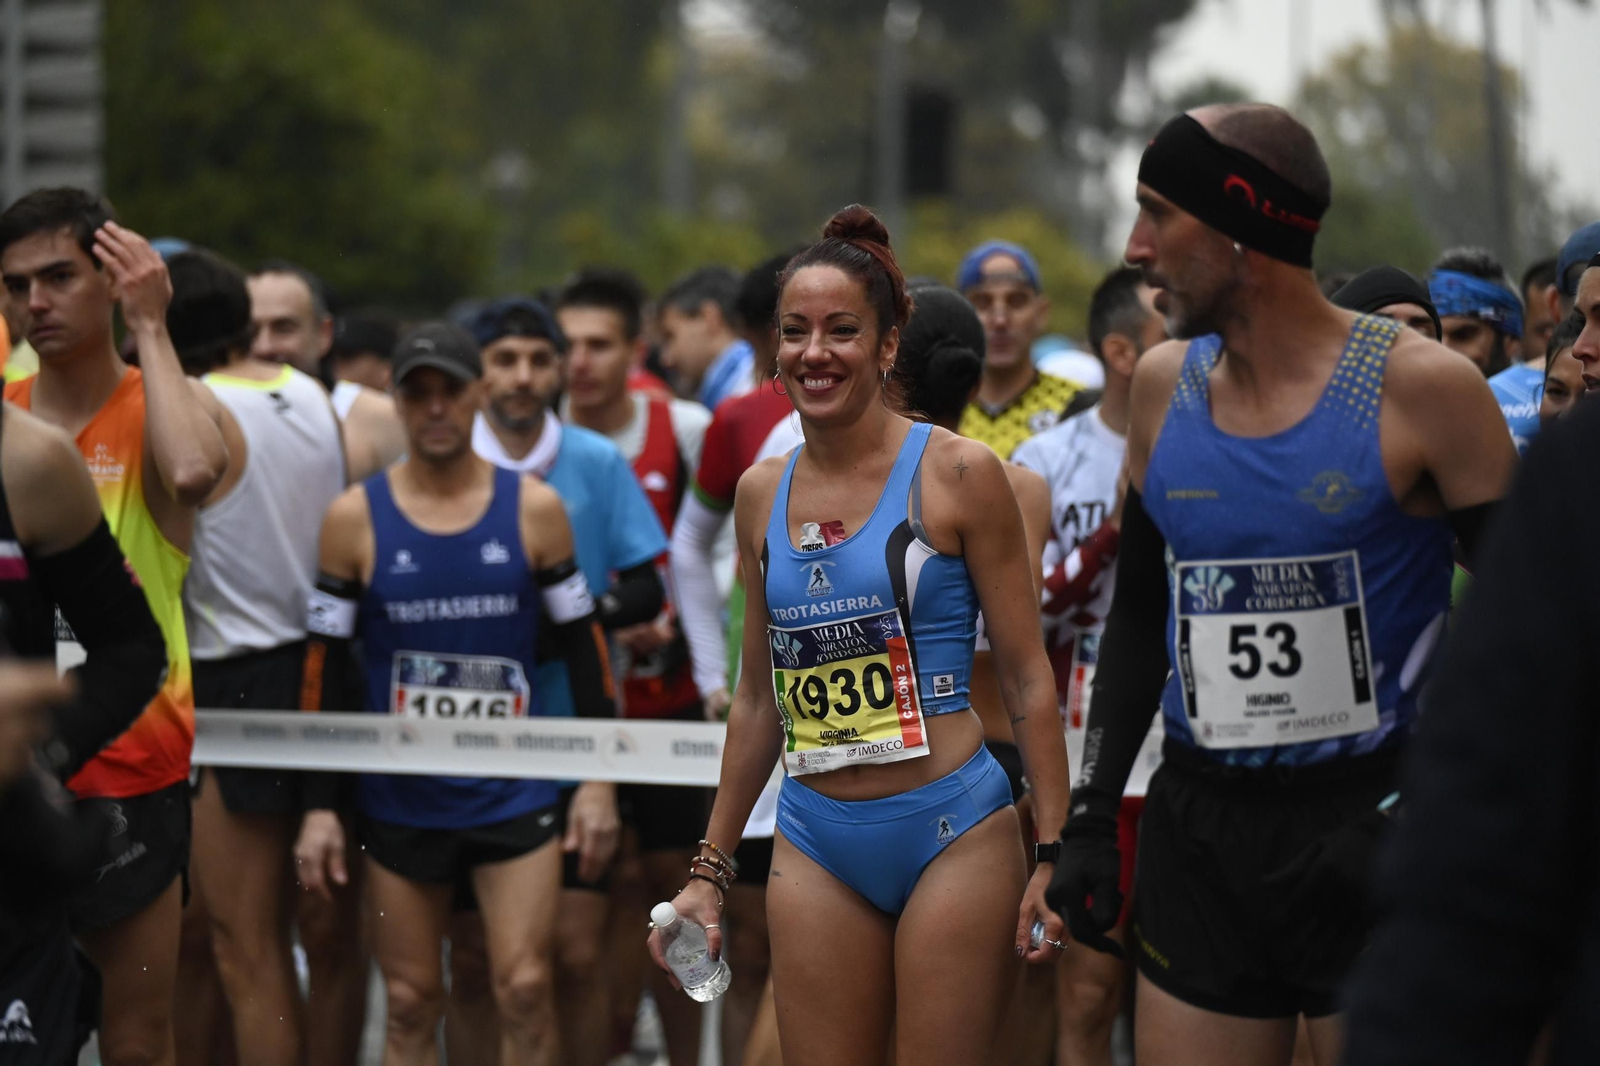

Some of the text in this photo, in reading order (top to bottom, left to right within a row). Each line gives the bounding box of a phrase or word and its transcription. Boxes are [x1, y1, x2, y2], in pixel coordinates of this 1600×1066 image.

[384, 593, 519, 623] TROTASIERRA
[773, 594, 883, 621] TROTASIERRA
[1192, 582, 1225, 612] 59
[811, 622, 865, 643] MEDIA
[1228, 622, 1302, 680] 53
[786, 662, 896, 721] 1930
[896, 664, 914, 719] CAJÓN 2
[1292, 711, 1350, 731] IMDECO
[858, 739, 904, 756] IMDECO
